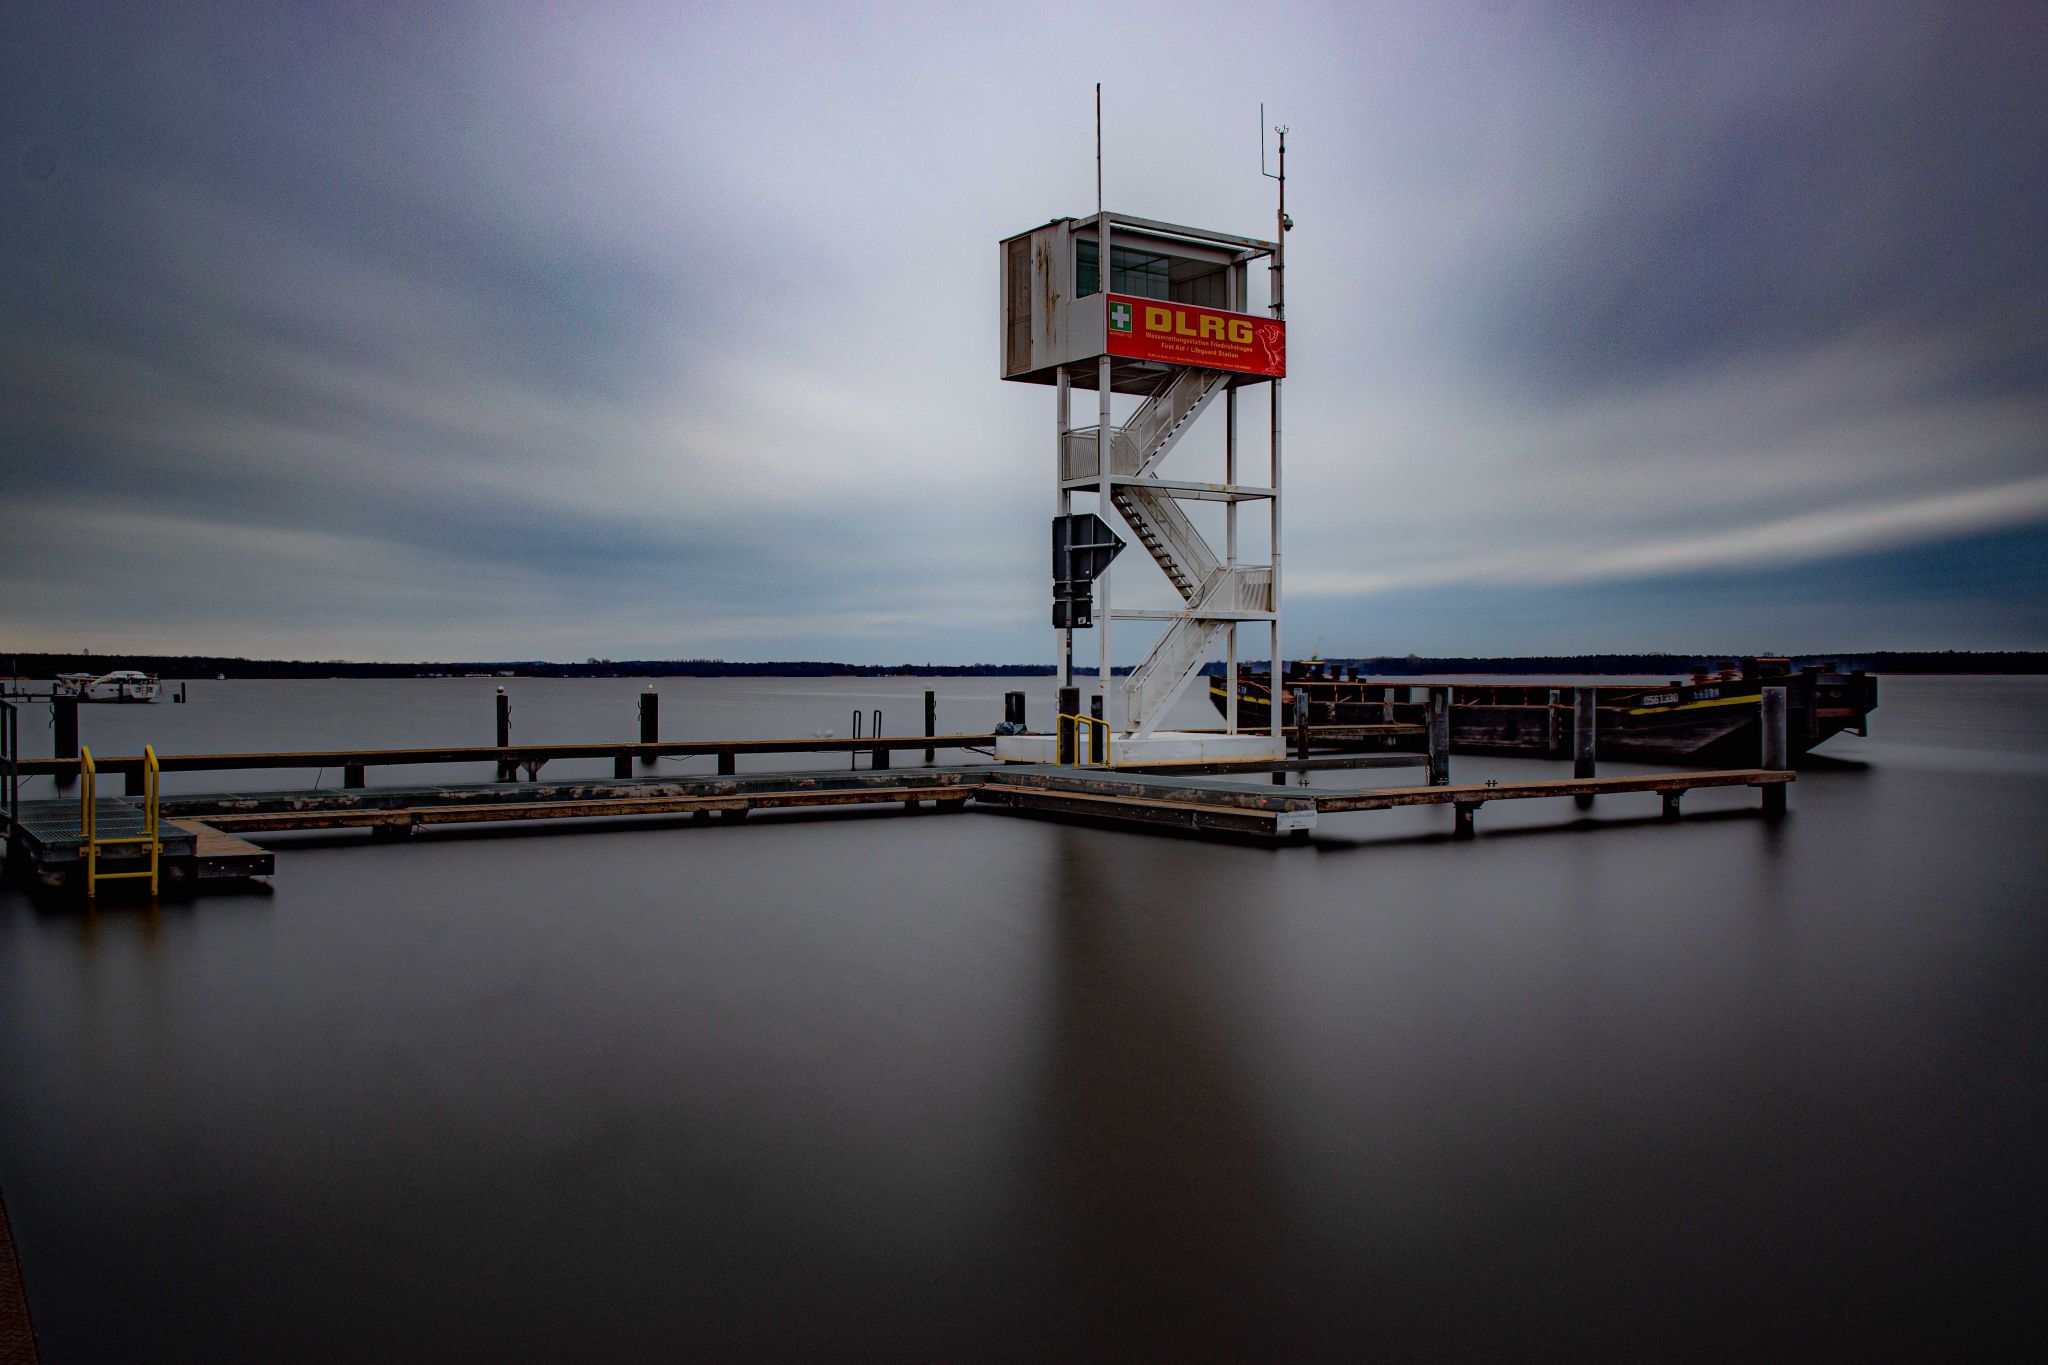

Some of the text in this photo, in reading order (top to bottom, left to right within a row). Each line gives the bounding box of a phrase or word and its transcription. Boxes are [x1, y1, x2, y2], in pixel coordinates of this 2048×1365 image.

[1145, 306, 1253, 344] DLRG
[1145, 332, 1209, 346] Wasserrettungsstation
[1161, 342, 1174, 350] First
[1190, 346, 1217, 356] Lifeguard
[1218, 350, 1239, 358] Station
